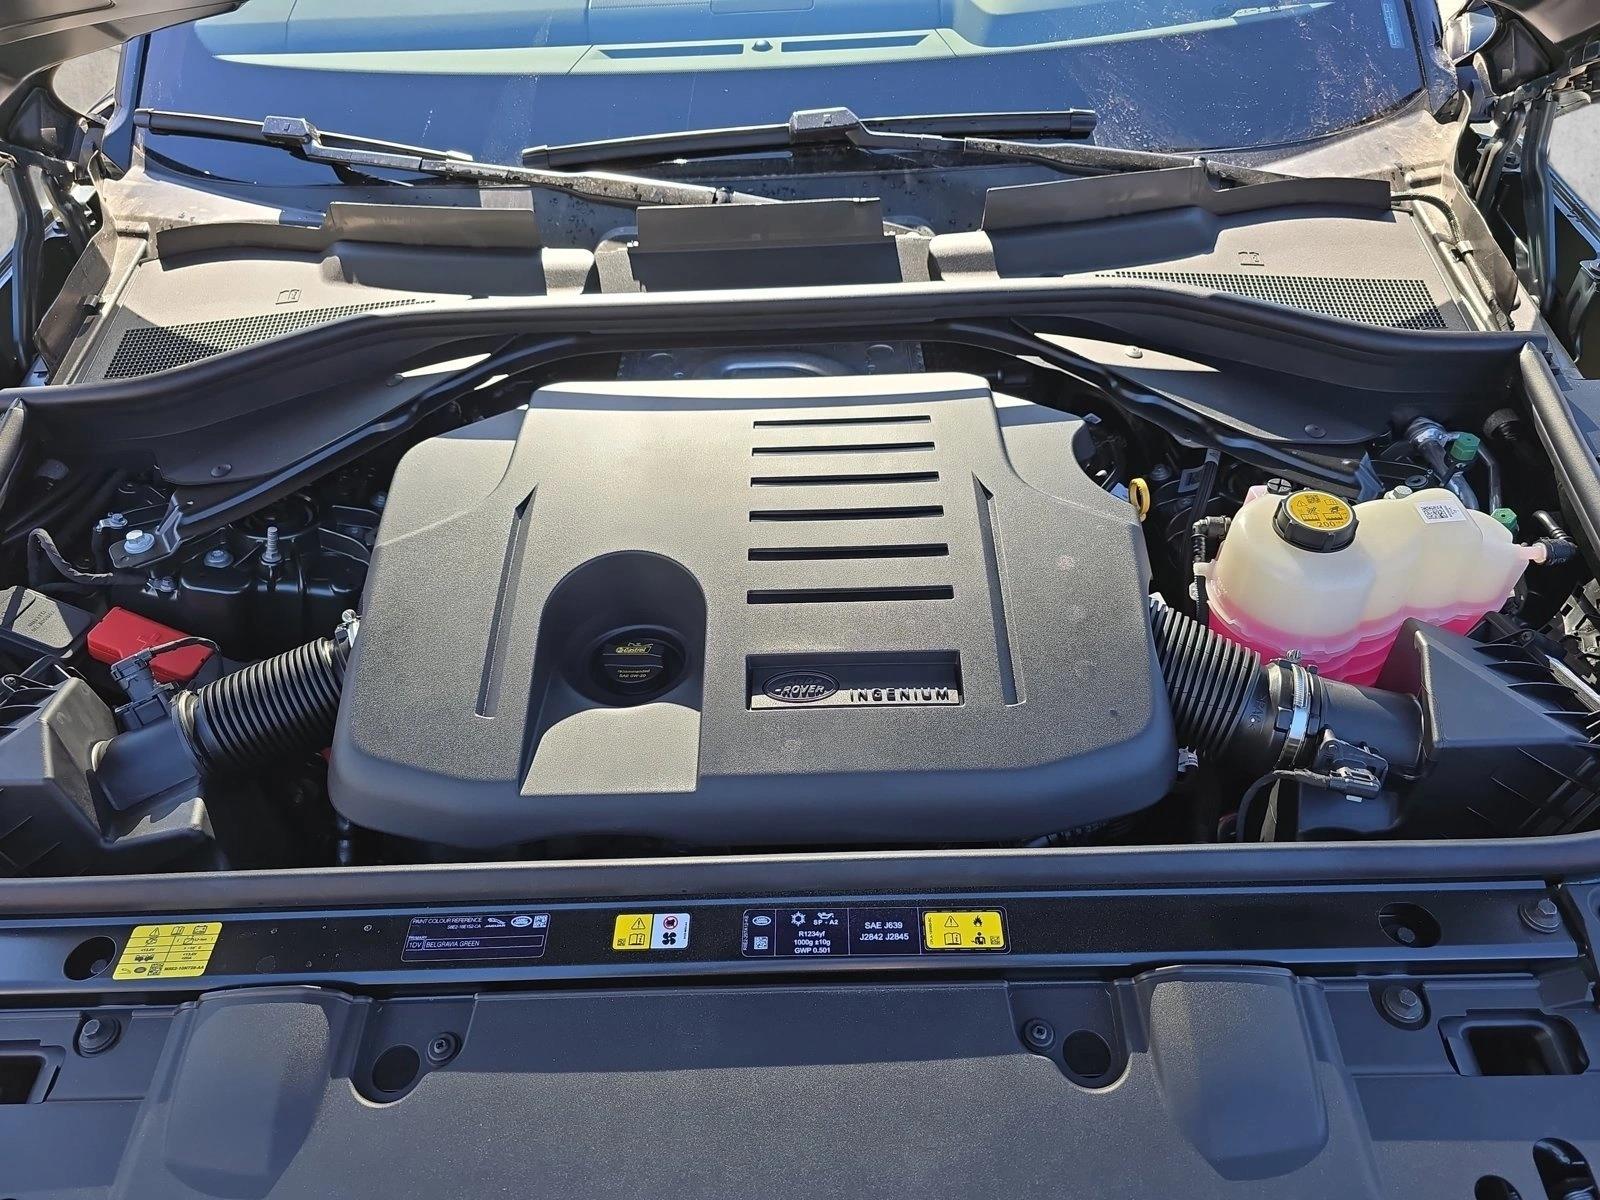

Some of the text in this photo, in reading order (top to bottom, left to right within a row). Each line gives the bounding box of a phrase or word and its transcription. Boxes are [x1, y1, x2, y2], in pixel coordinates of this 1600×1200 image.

[849, 687, 950, 702] INGENIUM
[412, 917, 429, 925] PAINT
[883, 921, 903, 929] J639
[798, 930, 826, 938] R1234yf
[859, 932, 909, 941] J2842 J2845
[409, 941, 422, 949] 1DV
[426, 940, 459, 948] BELGRAVIA
[794, 939, 814, 947] 1000g
